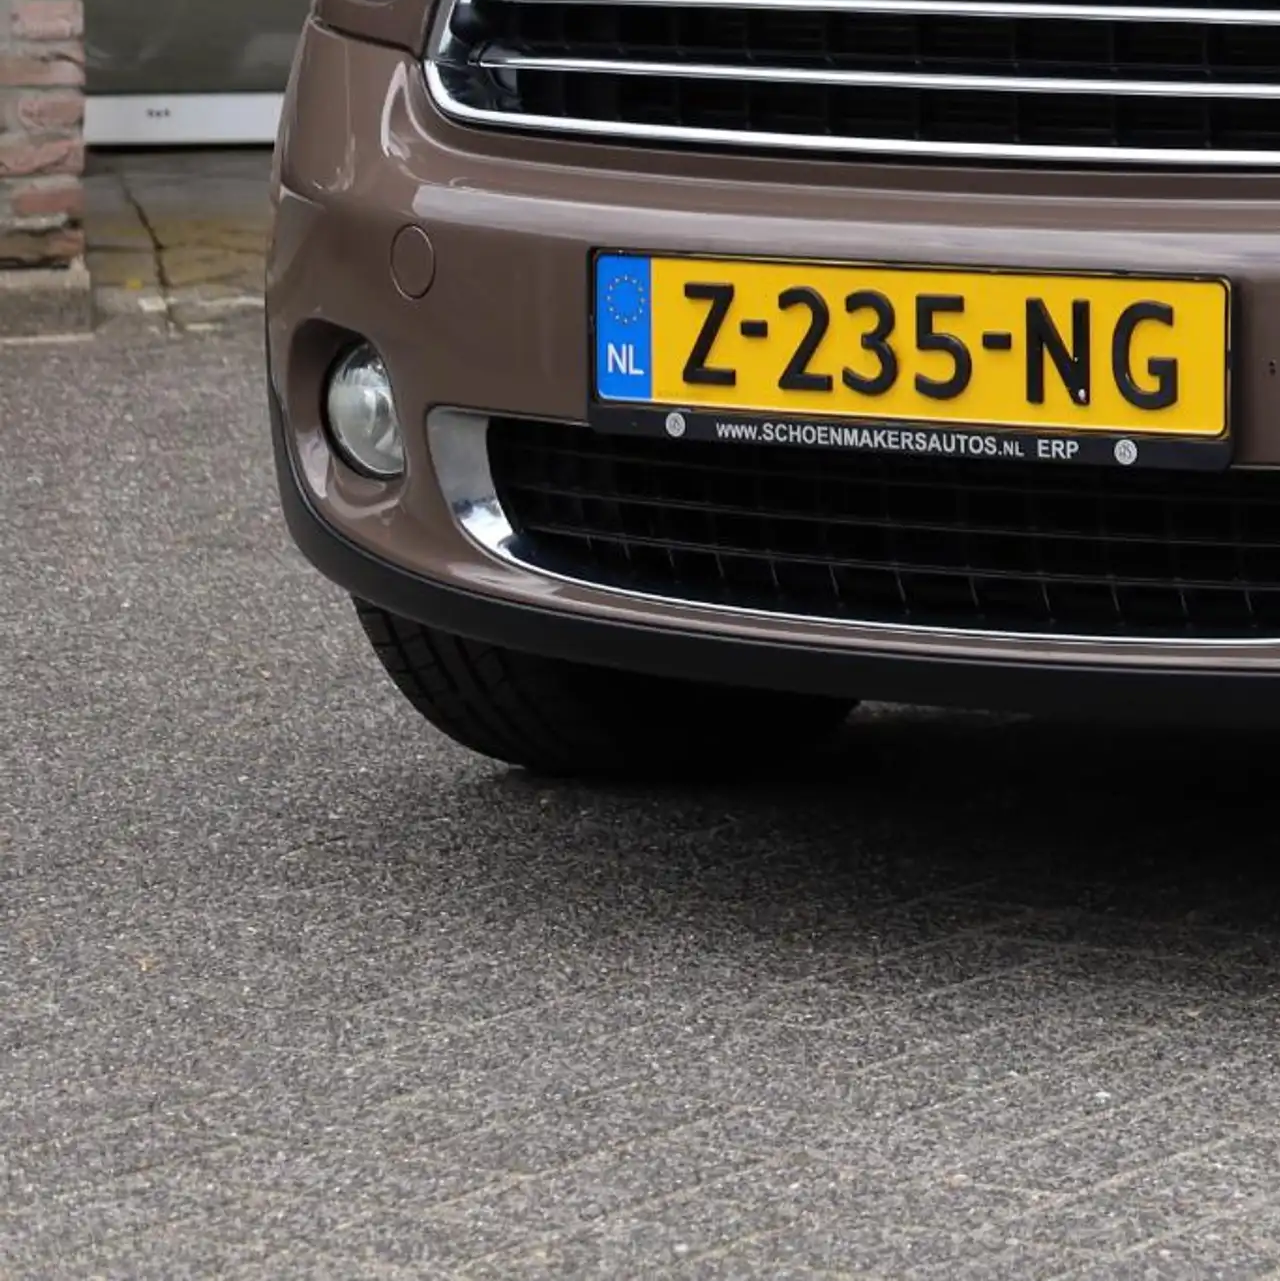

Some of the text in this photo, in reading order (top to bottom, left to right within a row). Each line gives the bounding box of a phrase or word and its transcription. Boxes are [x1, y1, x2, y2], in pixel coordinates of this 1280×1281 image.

[606, 343, 645, 377] NL
[682, 282, 1179, 412] Z-235-NG
[1037, 438, 1080, 460] ERP
